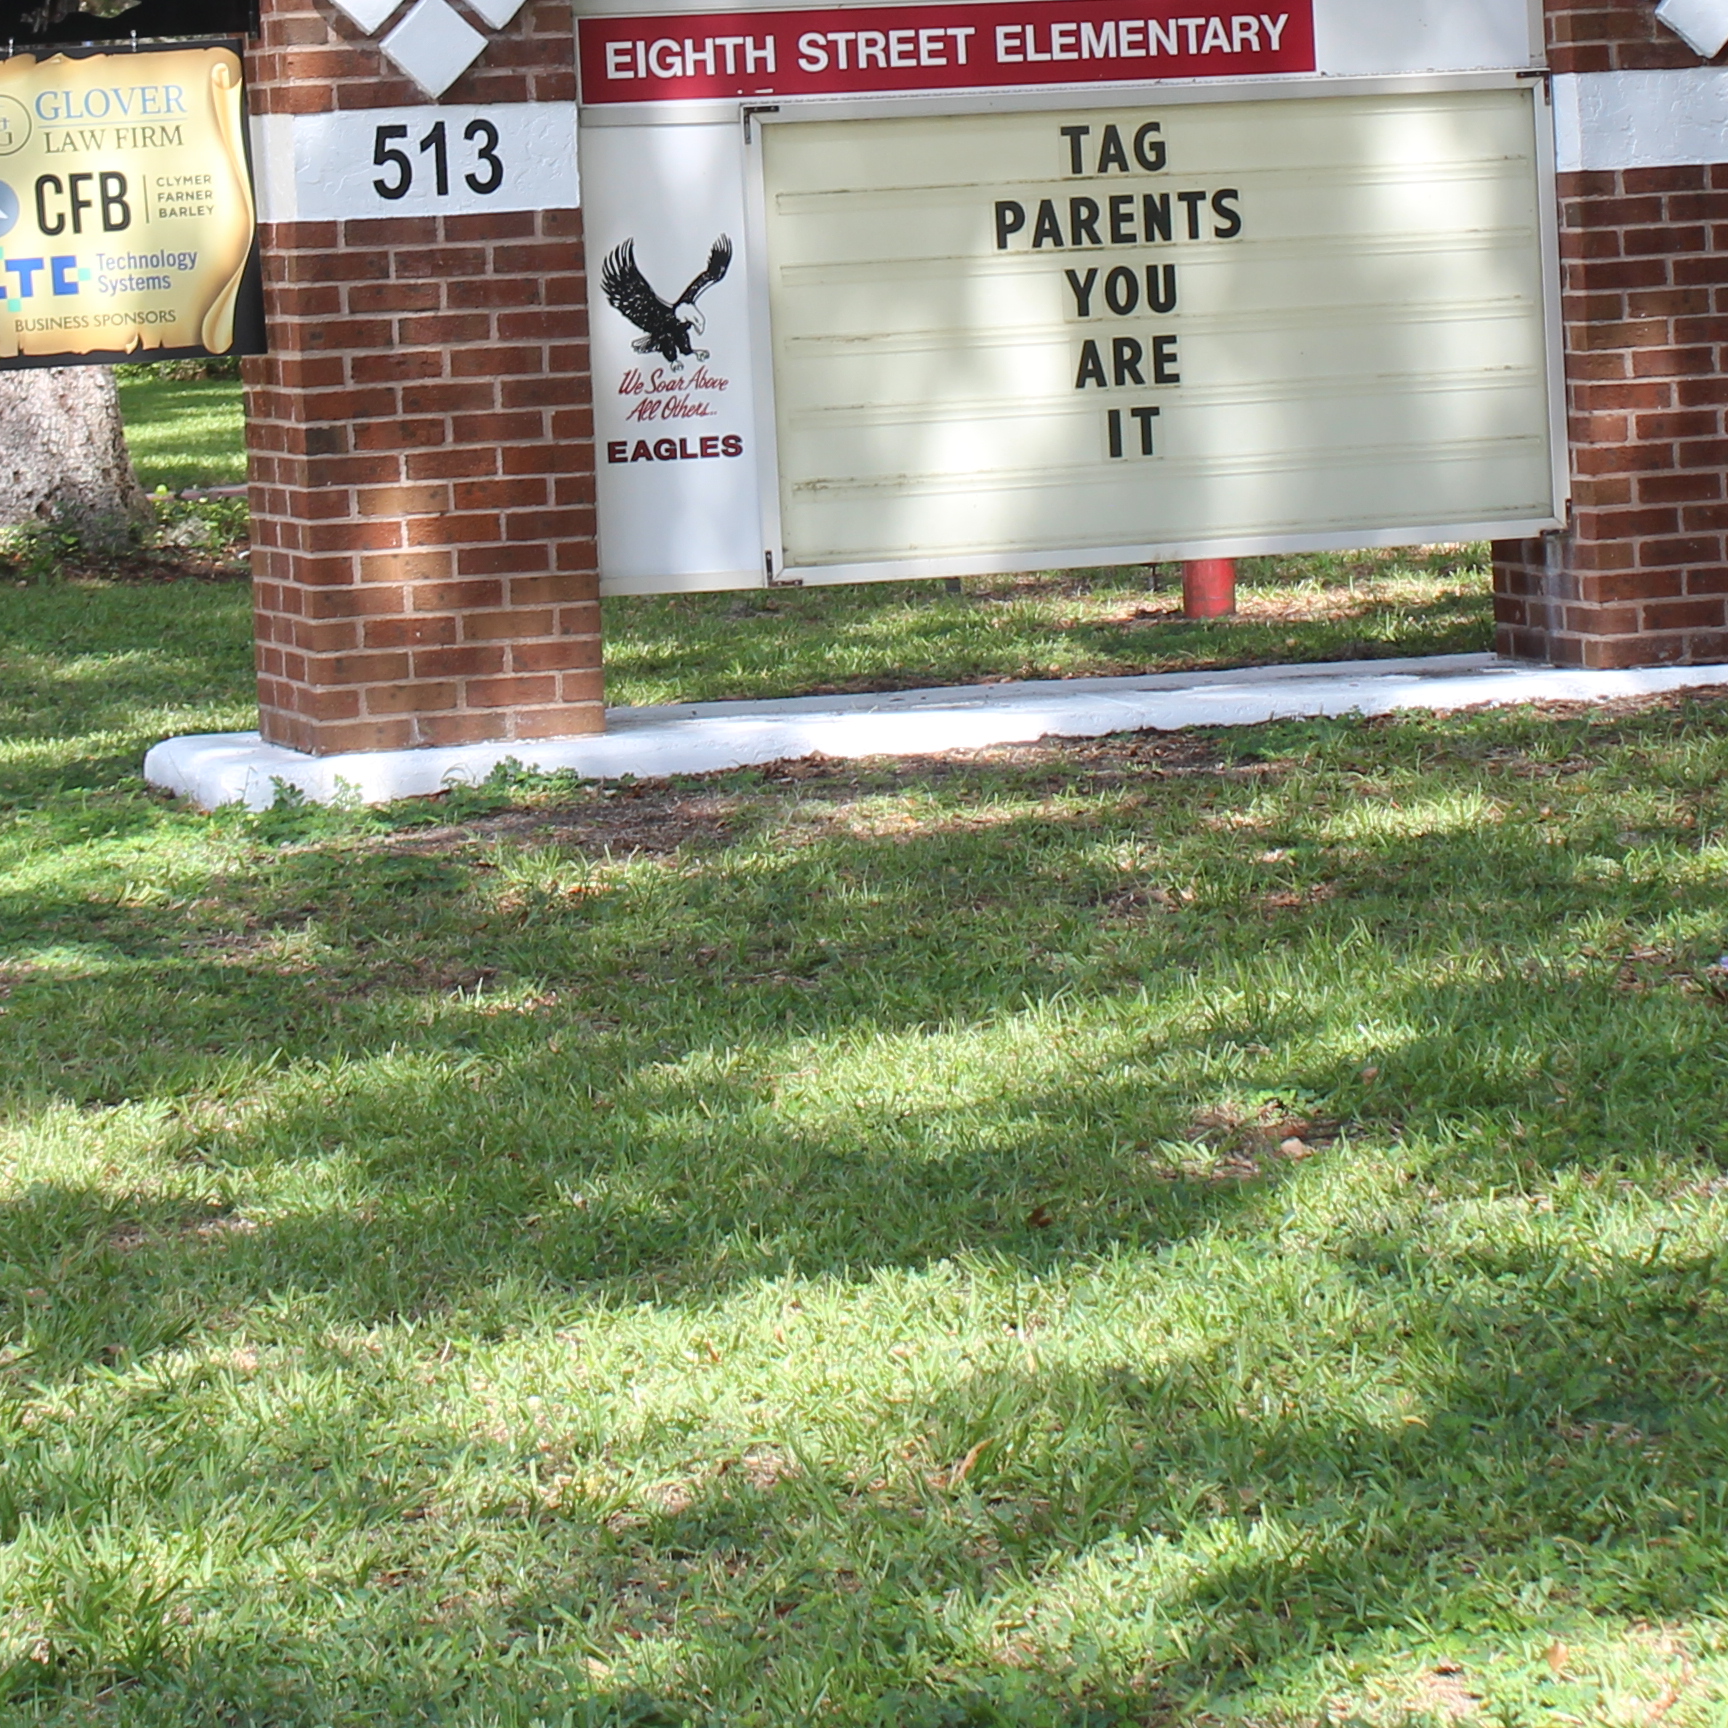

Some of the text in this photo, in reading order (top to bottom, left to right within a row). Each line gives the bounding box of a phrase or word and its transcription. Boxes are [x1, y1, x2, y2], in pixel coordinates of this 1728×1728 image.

[604, 13, 1289, 80] EIGHTH STREET ELEMENTARY
[34, 84, 188, 121] GLOVER
[43, 124, 185, 154] LAW FIRM
[1060, 121, 1167, 175] TAG
[372, 117, 505, 200] 513
[155, 174, 212, 187] CLYMER
[157, 189, 213, 203] FARNER
[34, 171, 132, 237] CFB
[158, 204, 215, 219] BARLEY
[994, 188, 1242, 250] PARENTS
[96, 249, 198, 272] Technology
[97, 272, 172, 297] Systems
[1064, 263, 1178, 318] YOU
[14, 309, 177, 333] BUSINESS SPONSORS
[1075, 334, 1181, 390] ARE
[618, 364, 730, 396] We Soar Above
[625, 397, 662, 423] All
[1107, 406, 1161, 459] IT
[607, 434, 744, 464] EAGLES
